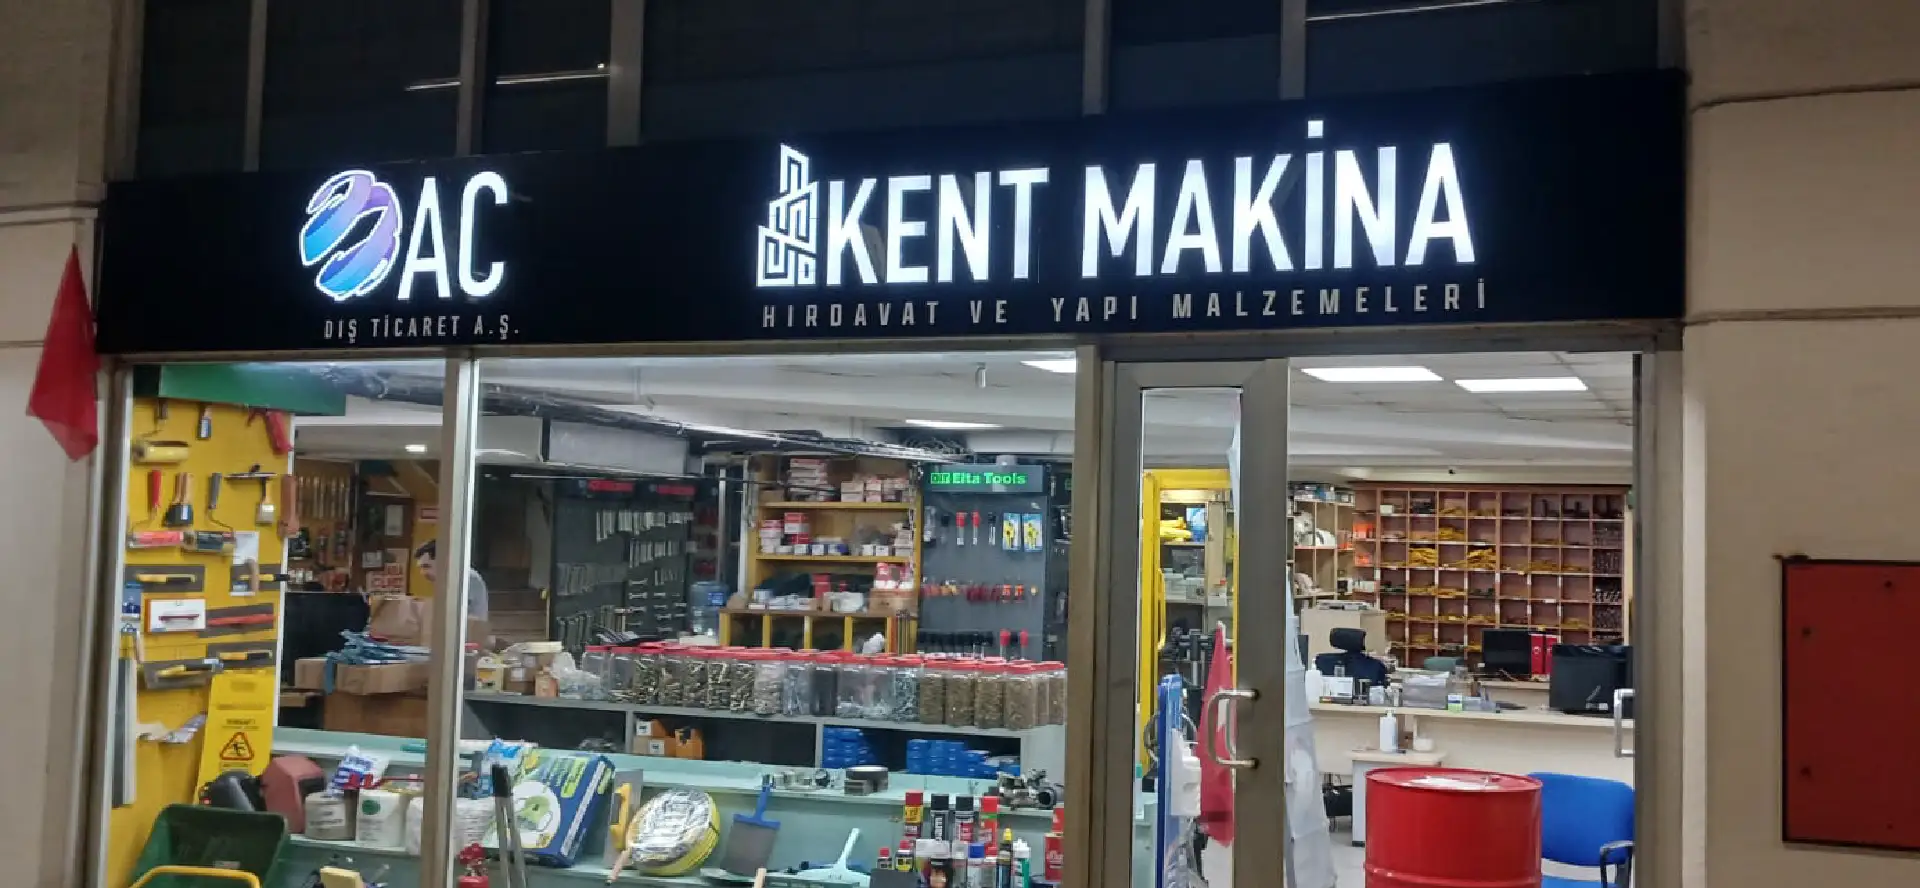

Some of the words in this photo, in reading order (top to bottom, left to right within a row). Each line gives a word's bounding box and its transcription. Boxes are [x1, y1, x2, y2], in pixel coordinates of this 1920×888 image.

[826, 167, 1049, 287] KENT
[1081, 120, 1475, 279] MAKİNA
[398, 171, 508, 301] AC
[324, 318, 358, 344] DIŞ
[371, 314, 460, 338] TİCARET
[473, 313, 520, 340] A.Ş.
[761, 300, 939, 329] HIRDAVAT
[970, 298, 1008, 325] VE
[1052, 295, 1138, 323] YAPI
[1172, 278, 1486, 319] MALZEMELERİ
[984, 473, 1026, 484] Tools
